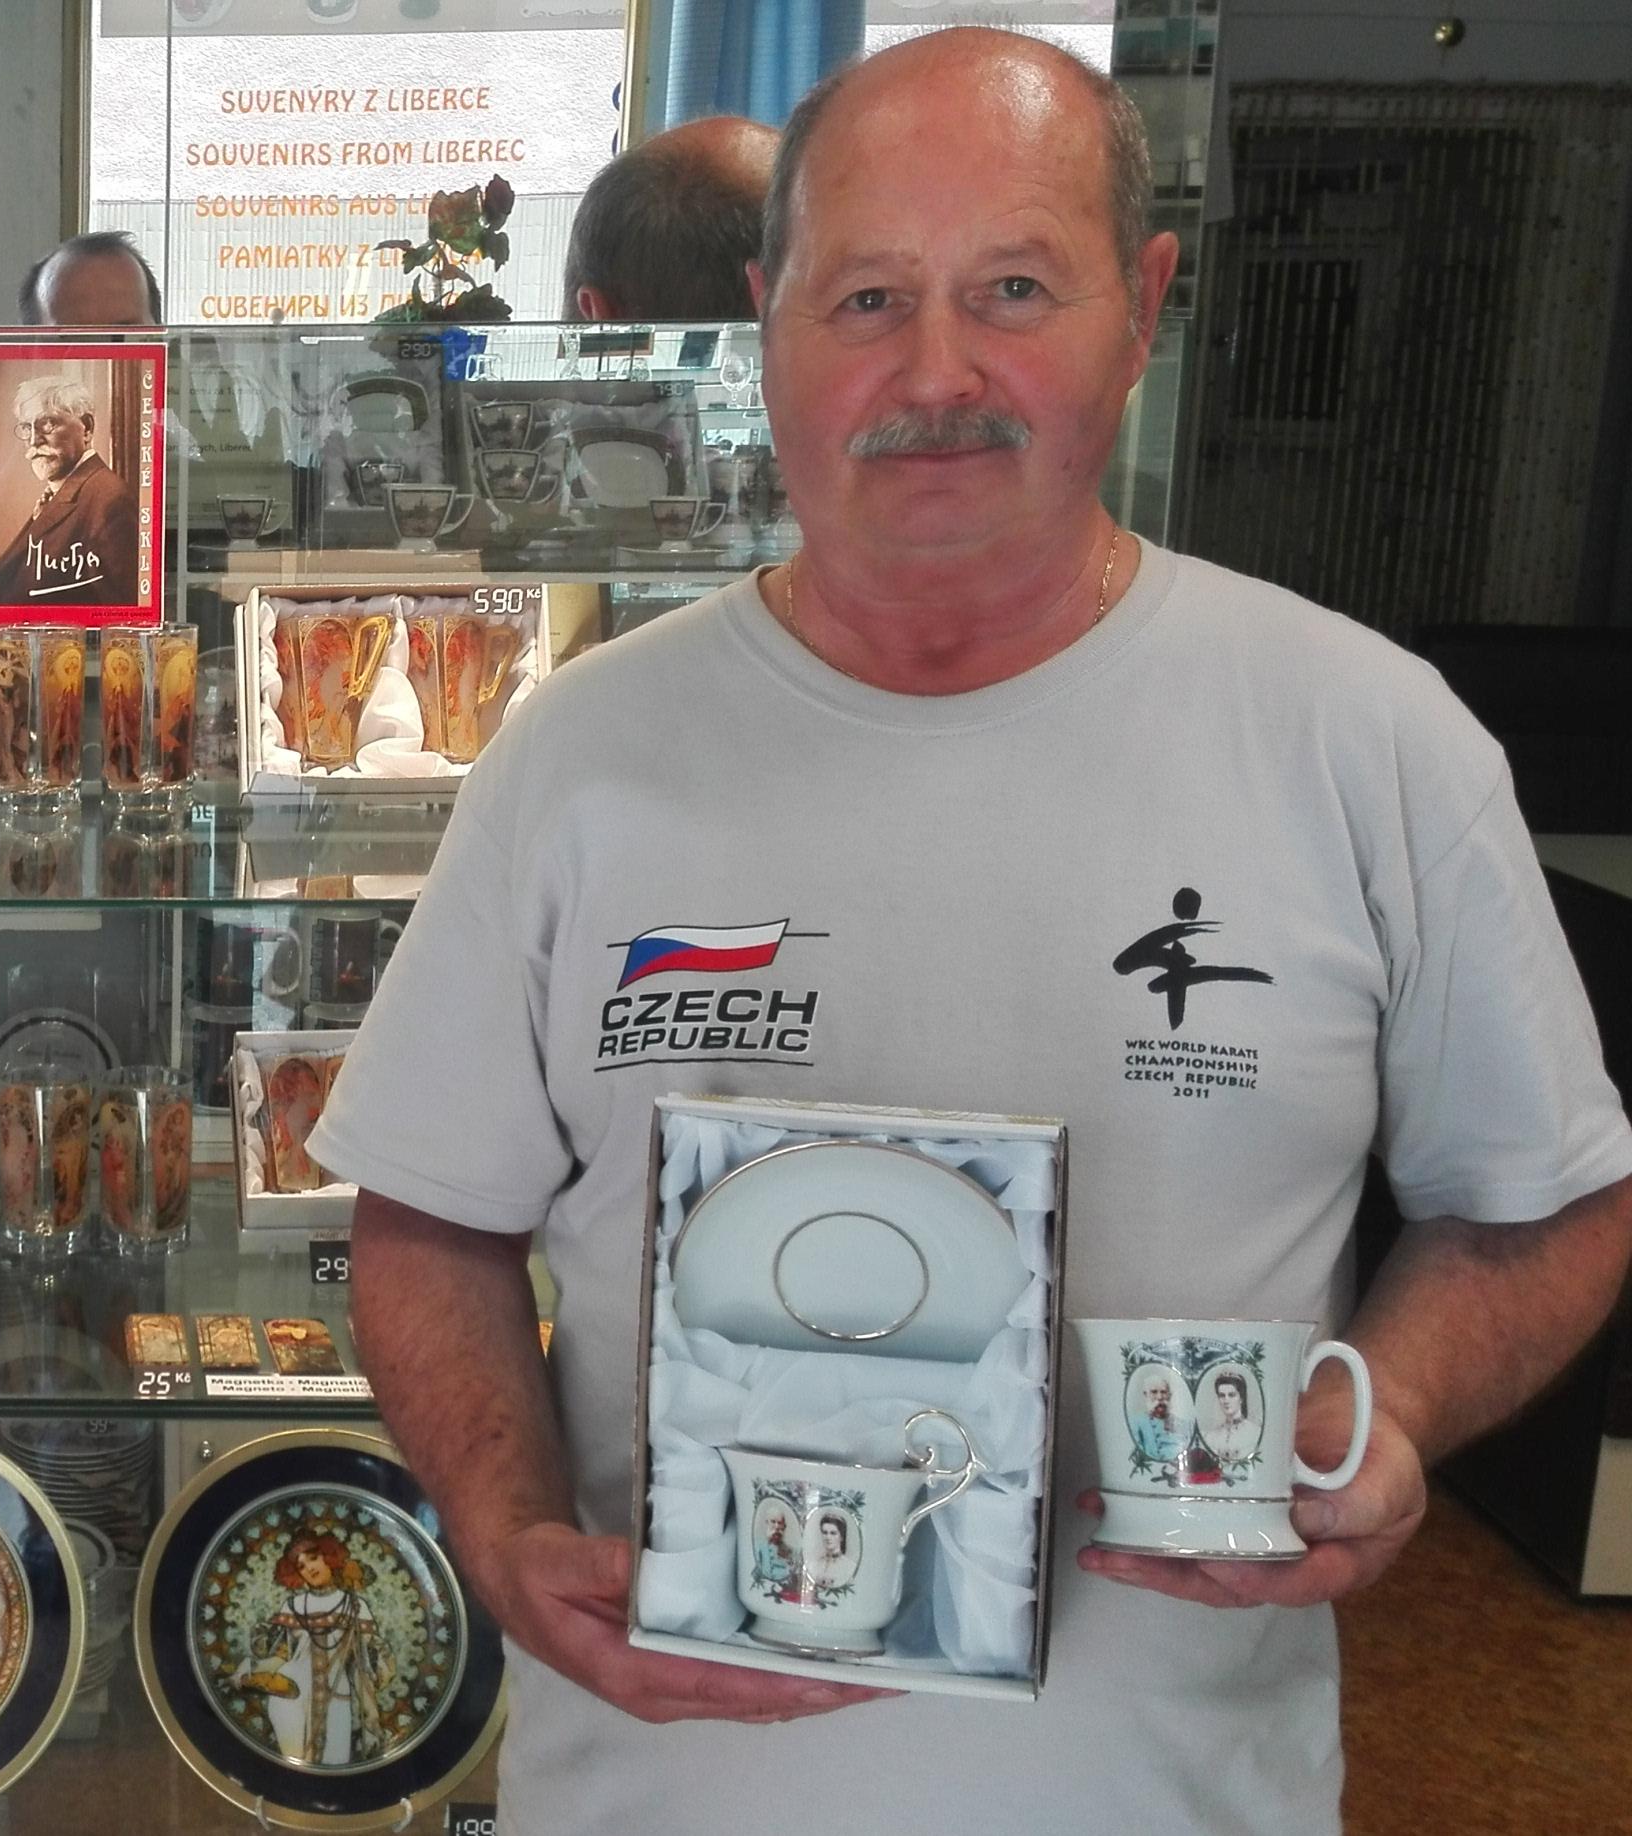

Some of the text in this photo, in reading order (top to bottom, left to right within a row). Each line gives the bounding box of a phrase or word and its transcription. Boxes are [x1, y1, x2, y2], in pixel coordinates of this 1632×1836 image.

[221, 84, 490, 113] SUVENÝRY Z LIBERCE
[187, 139, 525, 166] SOUVENIRS FROM LIBEREC
[196, 194, 339, 217] SOUVENIRS
[350, 193, 396, 216] AUS
[219, 244, 348, 268] PAMIATKY
[356, 244, 369, 267] Z
[401, 343, 430, 358] 290
[139, 369, 153, 596] ČESKÉ SKLO
[474, 588, 542, 613] 590 Kč
[601, 989, 818, 1032] CZECH
[597, 1026, 810, 1058] REPUBLIC
[1125, 1039, 1258, 1059] WKC WORLD KARATE
[1125, 1055, 1258, 1074] CHAMPIONSHIPS
[1125, 1070, 1256, 1089] CZECH REPUBLIC
[1173, 1086, 1209, 1099] 2011
[138, 1372, 191, 1394] 25 Kč
